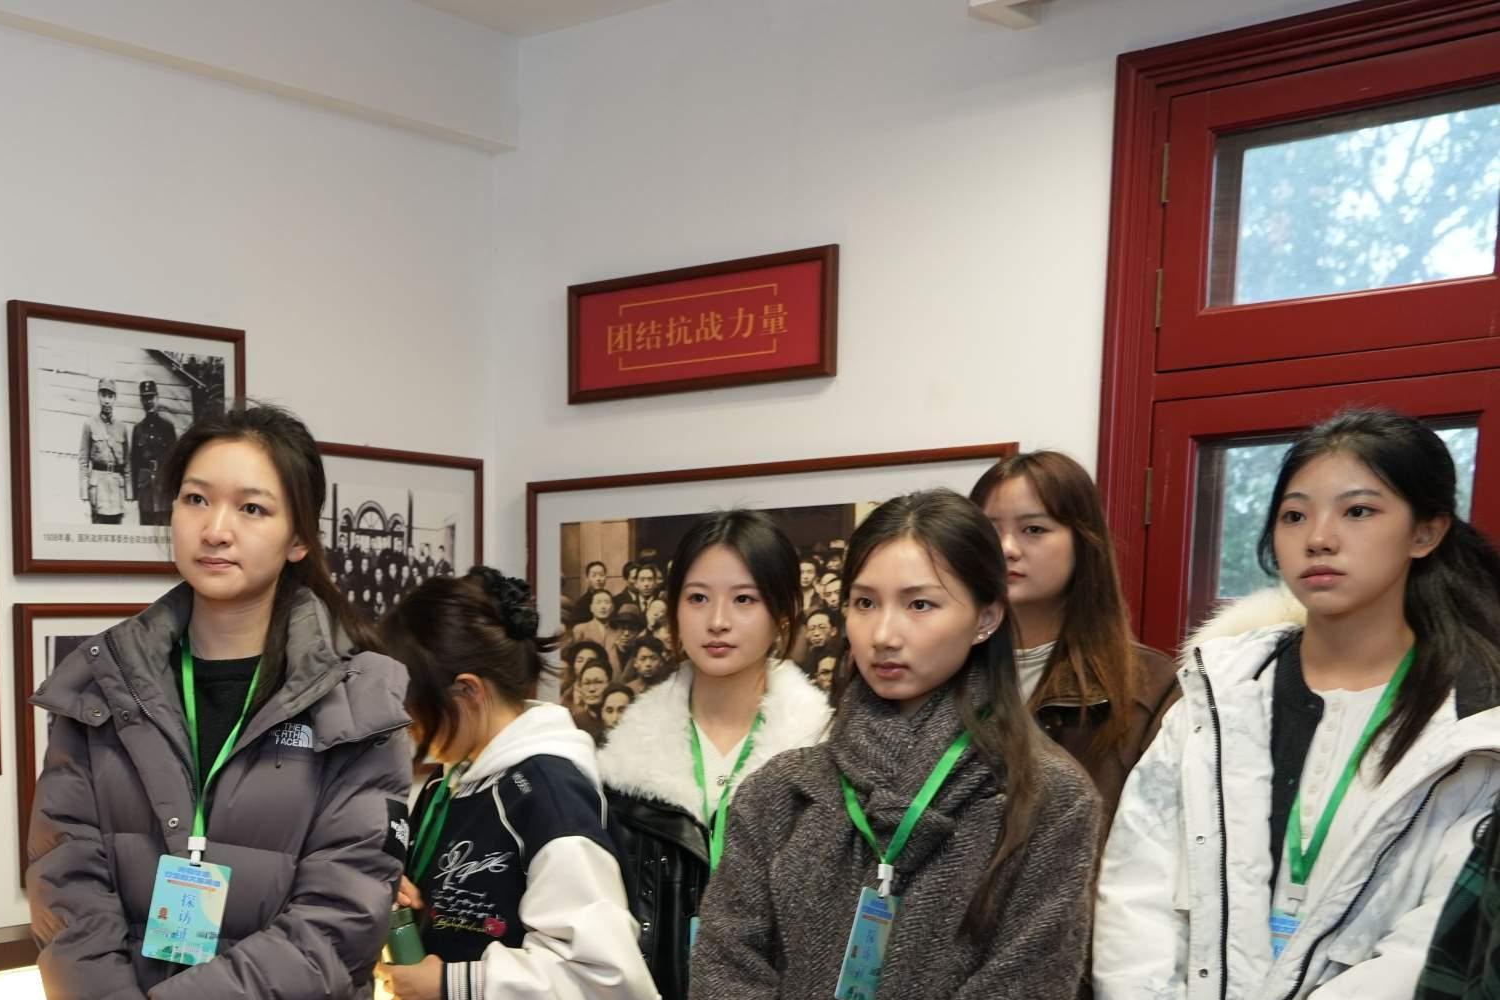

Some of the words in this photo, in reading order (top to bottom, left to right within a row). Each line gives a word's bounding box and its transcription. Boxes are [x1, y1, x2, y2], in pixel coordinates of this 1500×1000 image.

[606, 303, 788, 355] 团结抗战力量
[284, 722, 301, 732] THE
[275, 735, 300, 747] FACE
